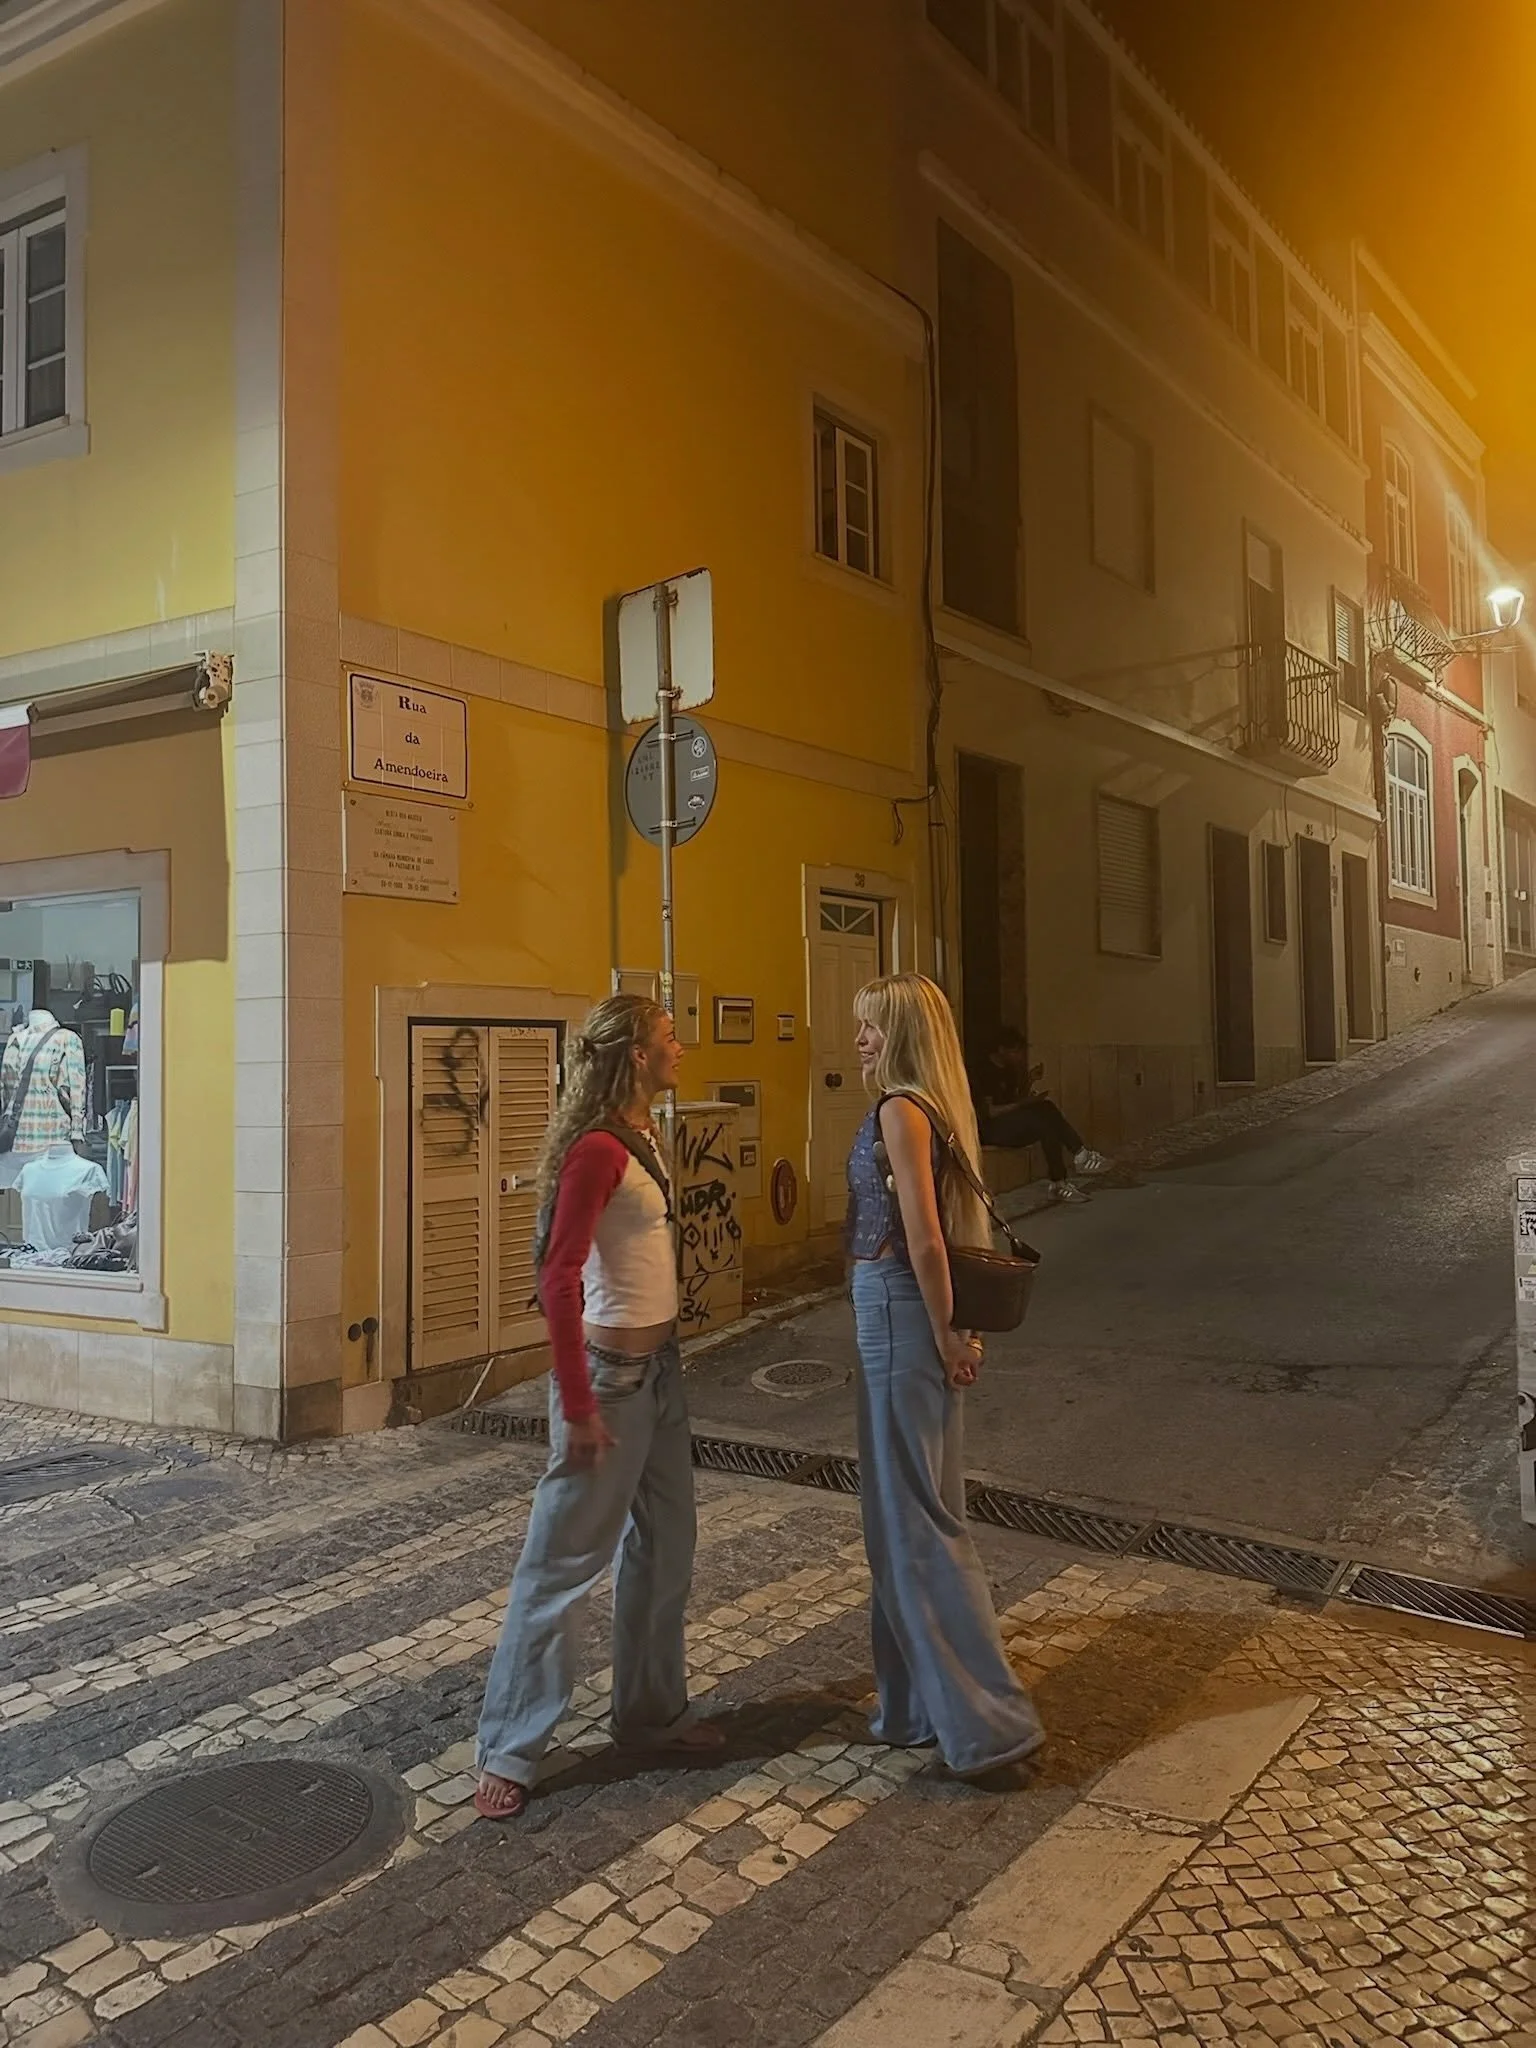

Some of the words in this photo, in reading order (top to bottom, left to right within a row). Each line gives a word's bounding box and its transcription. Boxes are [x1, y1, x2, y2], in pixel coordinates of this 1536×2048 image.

[398, 695, 428, 714] Rua
[405, 731, 421, 746] da
[374, 757, 449, 783] Amendoeira
